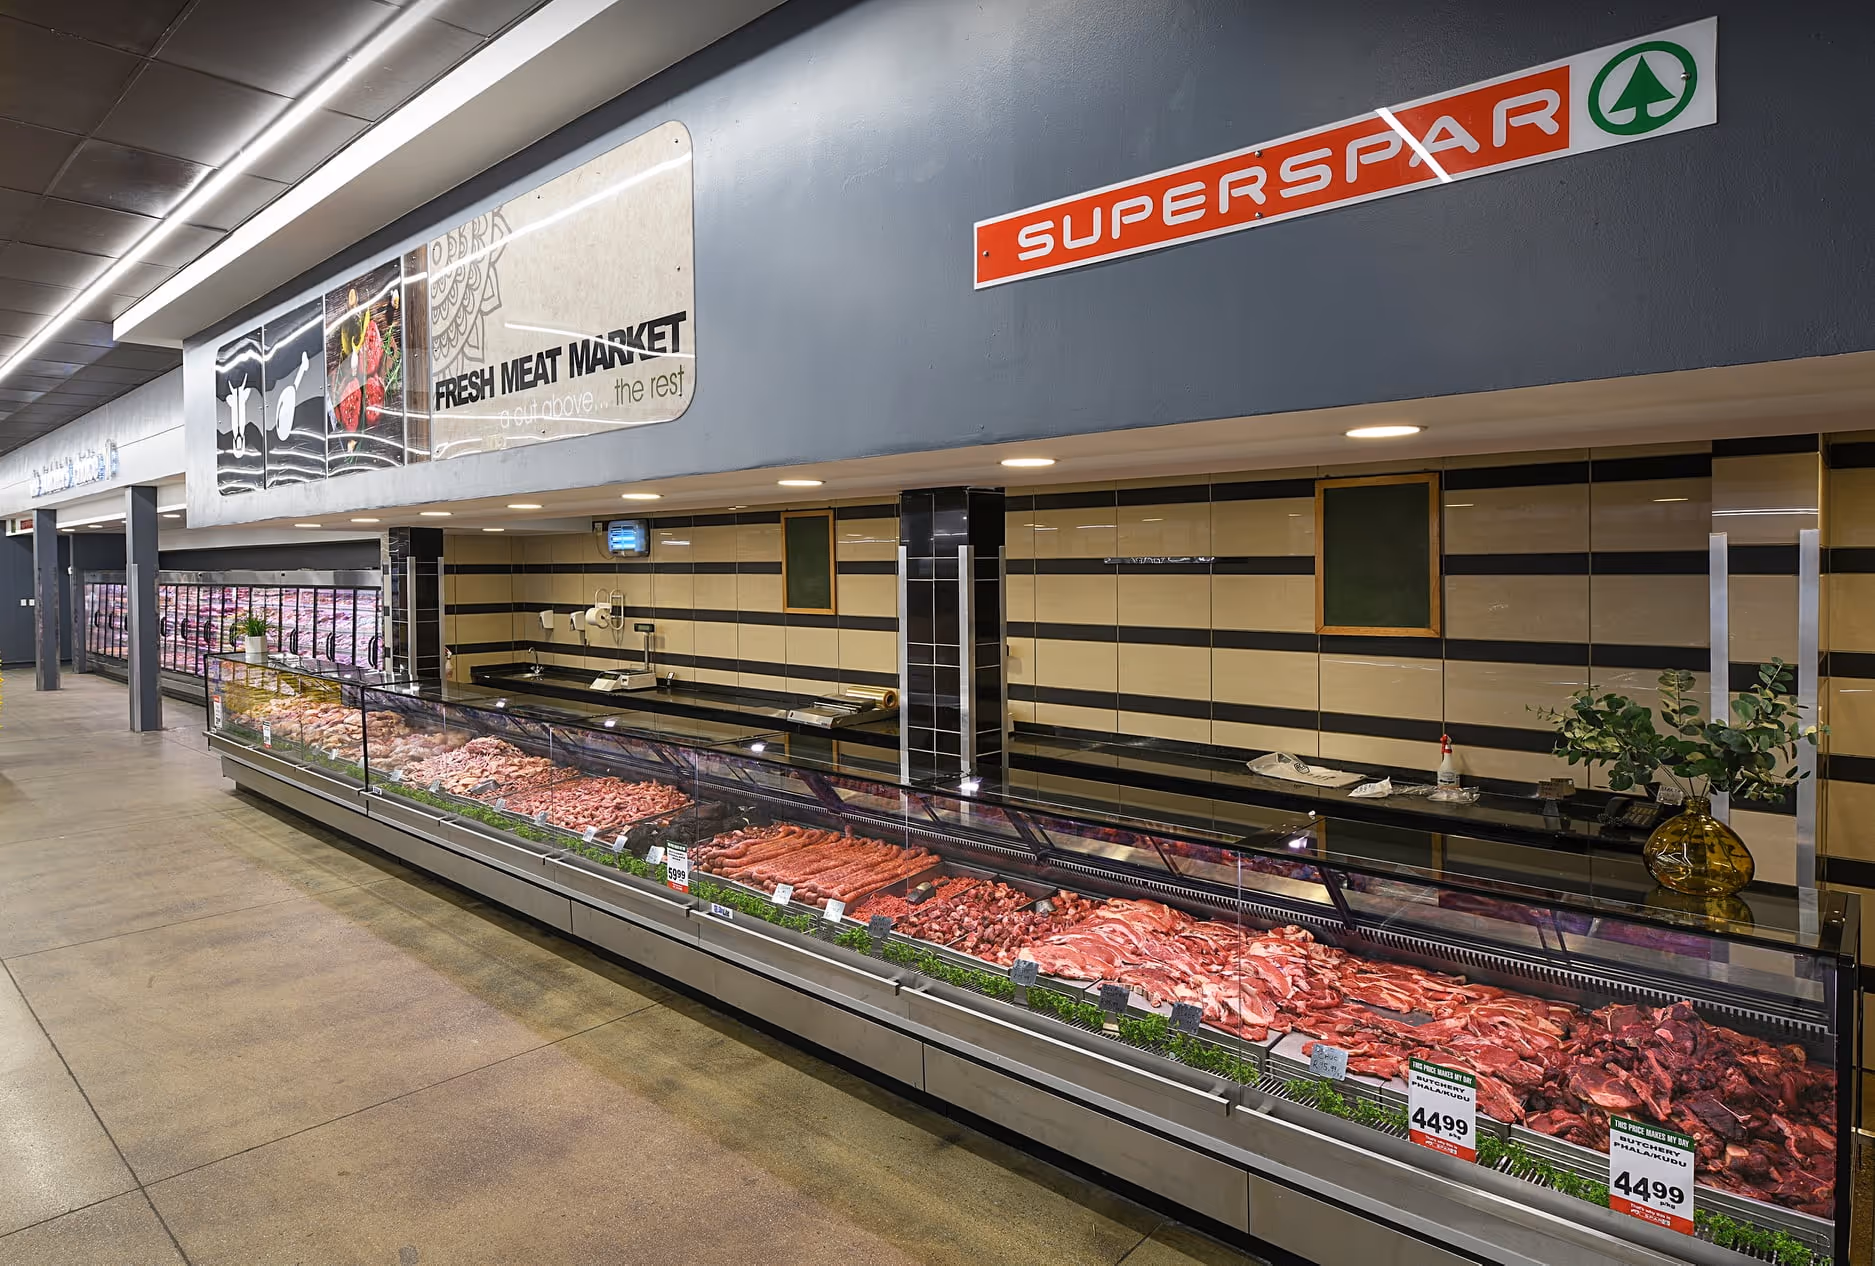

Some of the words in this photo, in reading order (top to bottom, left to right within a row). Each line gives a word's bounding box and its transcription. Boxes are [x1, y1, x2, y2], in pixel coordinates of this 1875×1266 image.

[1017, 87, 1562, 262] SUPERSPAR
[435, 365, 495, 411] FRESH
[501, 346, 562, 395] MEAT
[569, 311, 687, 378] MARKET
[499, 409, 510, 429] a
[513, 398, 538, 424] cut
[614, 377, 644, 406] the
[650, 364, 685, 398] rest
[1411, 1080, 1470, 1102] PHALA/KUDU
[1416, 1075, 1465, 1093] BUTCHERY
[1615, 1119, 1628, 1130] THIS
[1628, 1123, 1645, 1136] PRICE
[1646, 1128, 1666, 1141] MAKES
[1667, 1134, 1677, 1144] MY
[1677, 1138, 1690, 1148] DAY
[1619, 1135, 1681, 1157] BUTCHERY
[1613, 1141, 1687, 1168] PHALA/KUDU
[1613, 1170, 1685, 1205] 4499
